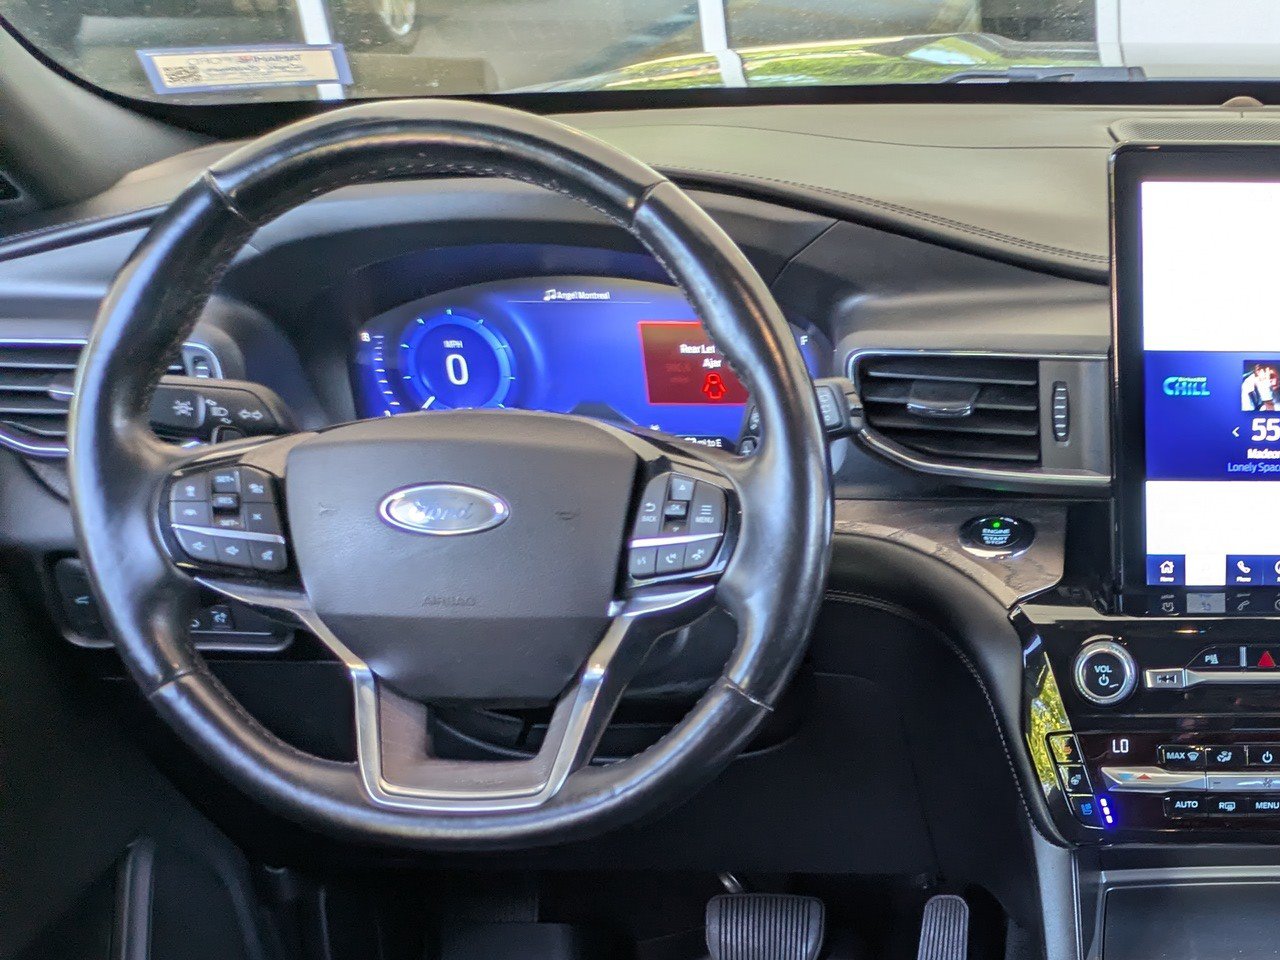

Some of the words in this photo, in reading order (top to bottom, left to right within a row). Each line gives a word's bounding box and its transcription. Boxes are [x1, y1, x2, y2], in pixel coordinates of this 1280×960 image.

[445, 353, 470, 386] 0
[1227, 462, 1257, 474] Lonely
[1094, 665, 1113, 674] VOL
[1112, 739, 1130, 754] LO
[1166, 751, 1186, 761] MAX
[1175, 800, 1199, 809] AUTO
[1255, 802, 1280, 810] MENU
